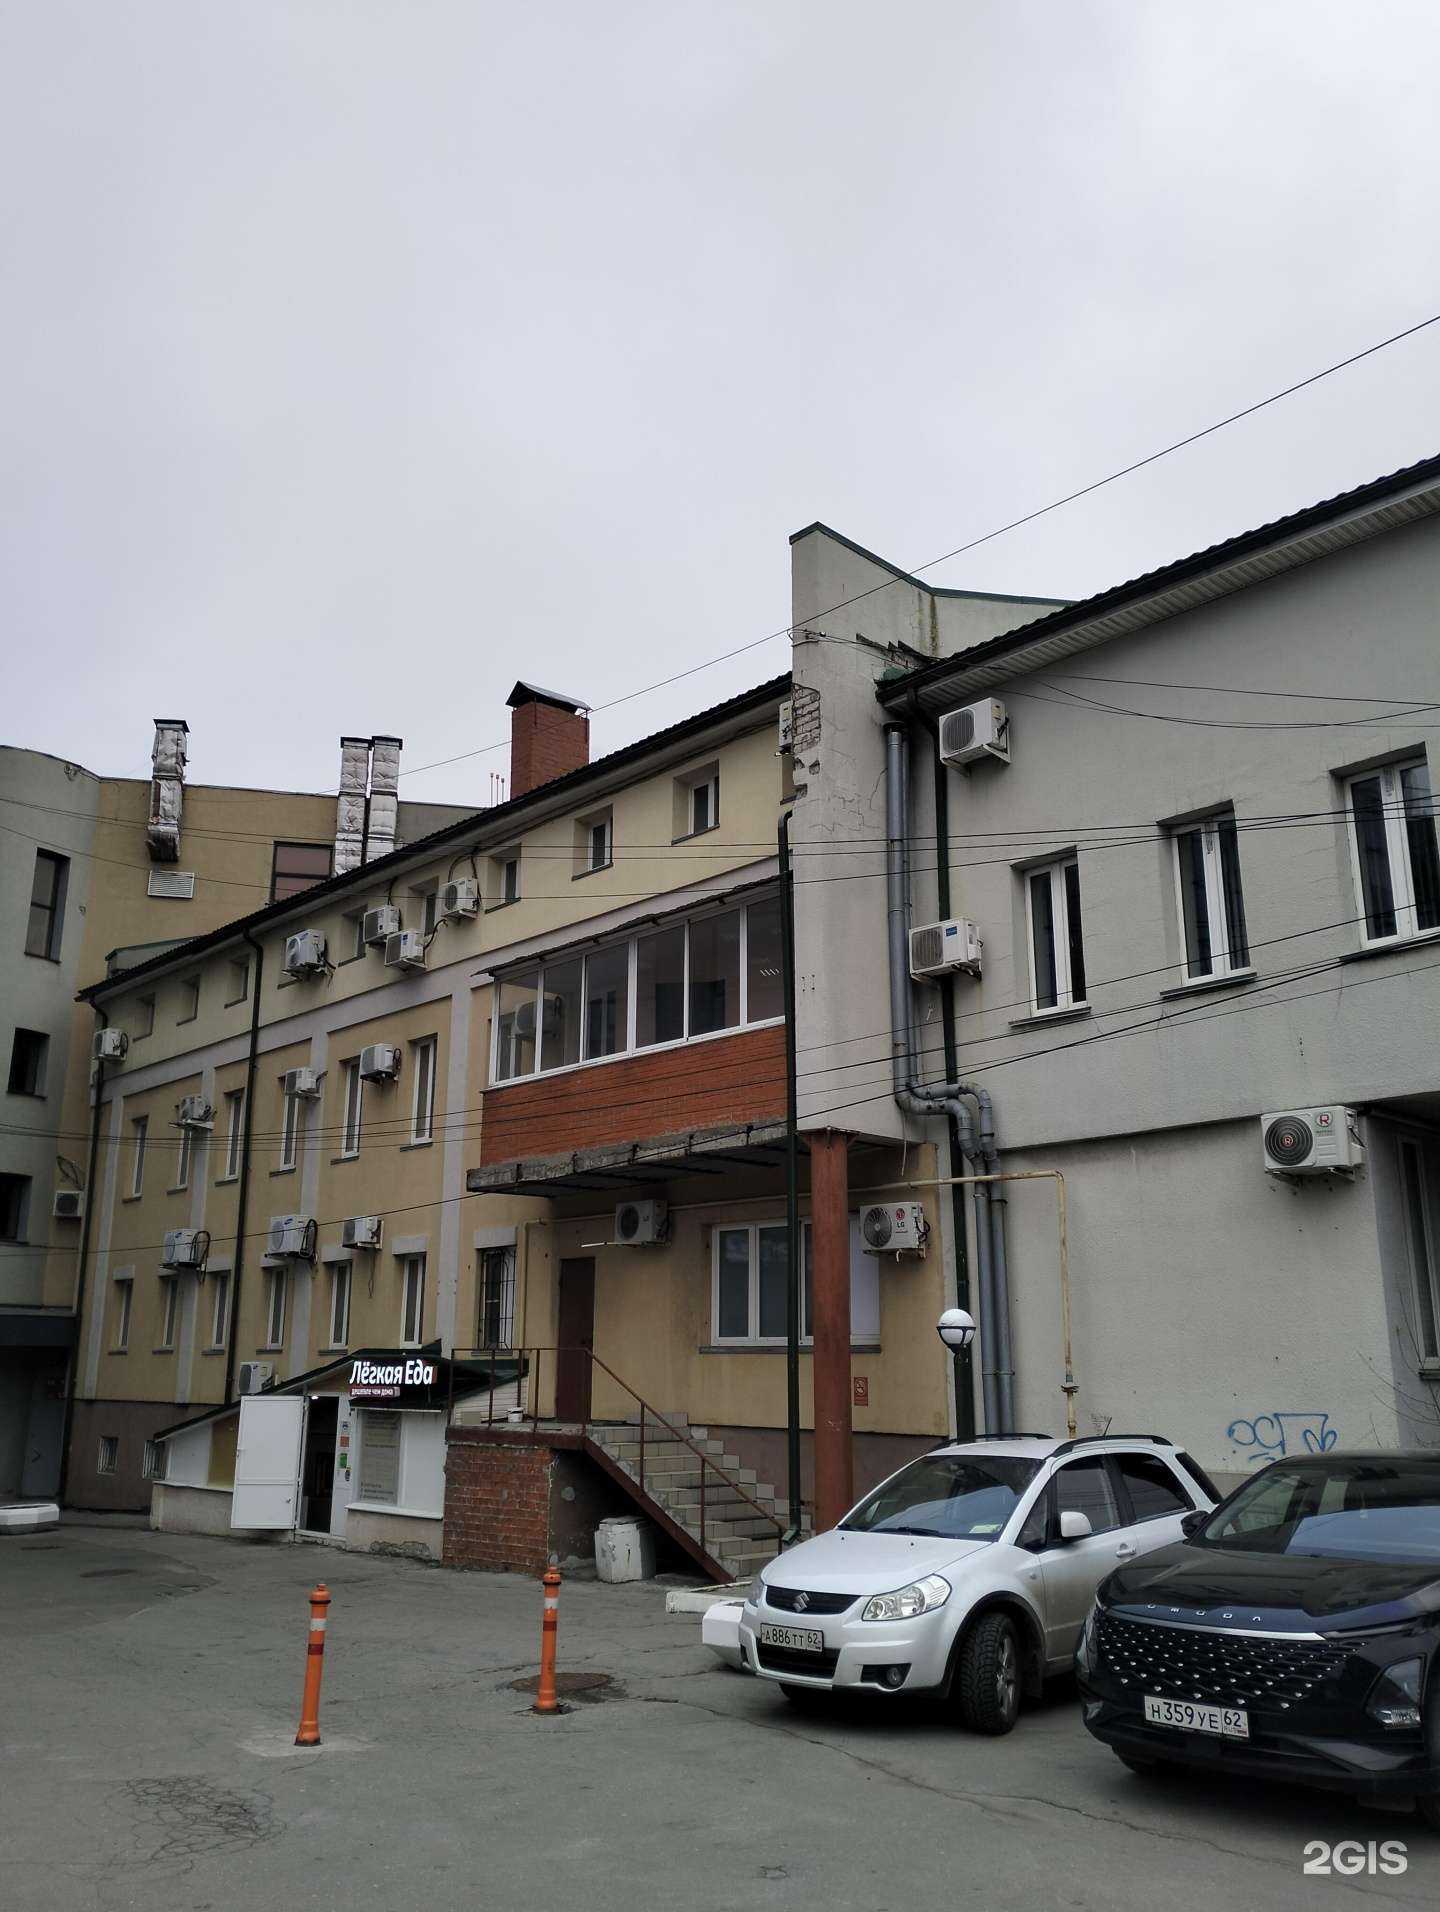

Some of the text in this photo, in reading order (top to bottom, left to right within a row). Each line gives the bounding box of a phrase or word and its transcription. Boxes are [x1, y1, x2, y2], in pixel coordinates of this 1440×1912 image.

[349, 1359, 433, 1385] Лёгкая Еда
[807, 1632, 818, 1645] 62
[1151, 1702, 1242, 1729] Н359УЕ 62
